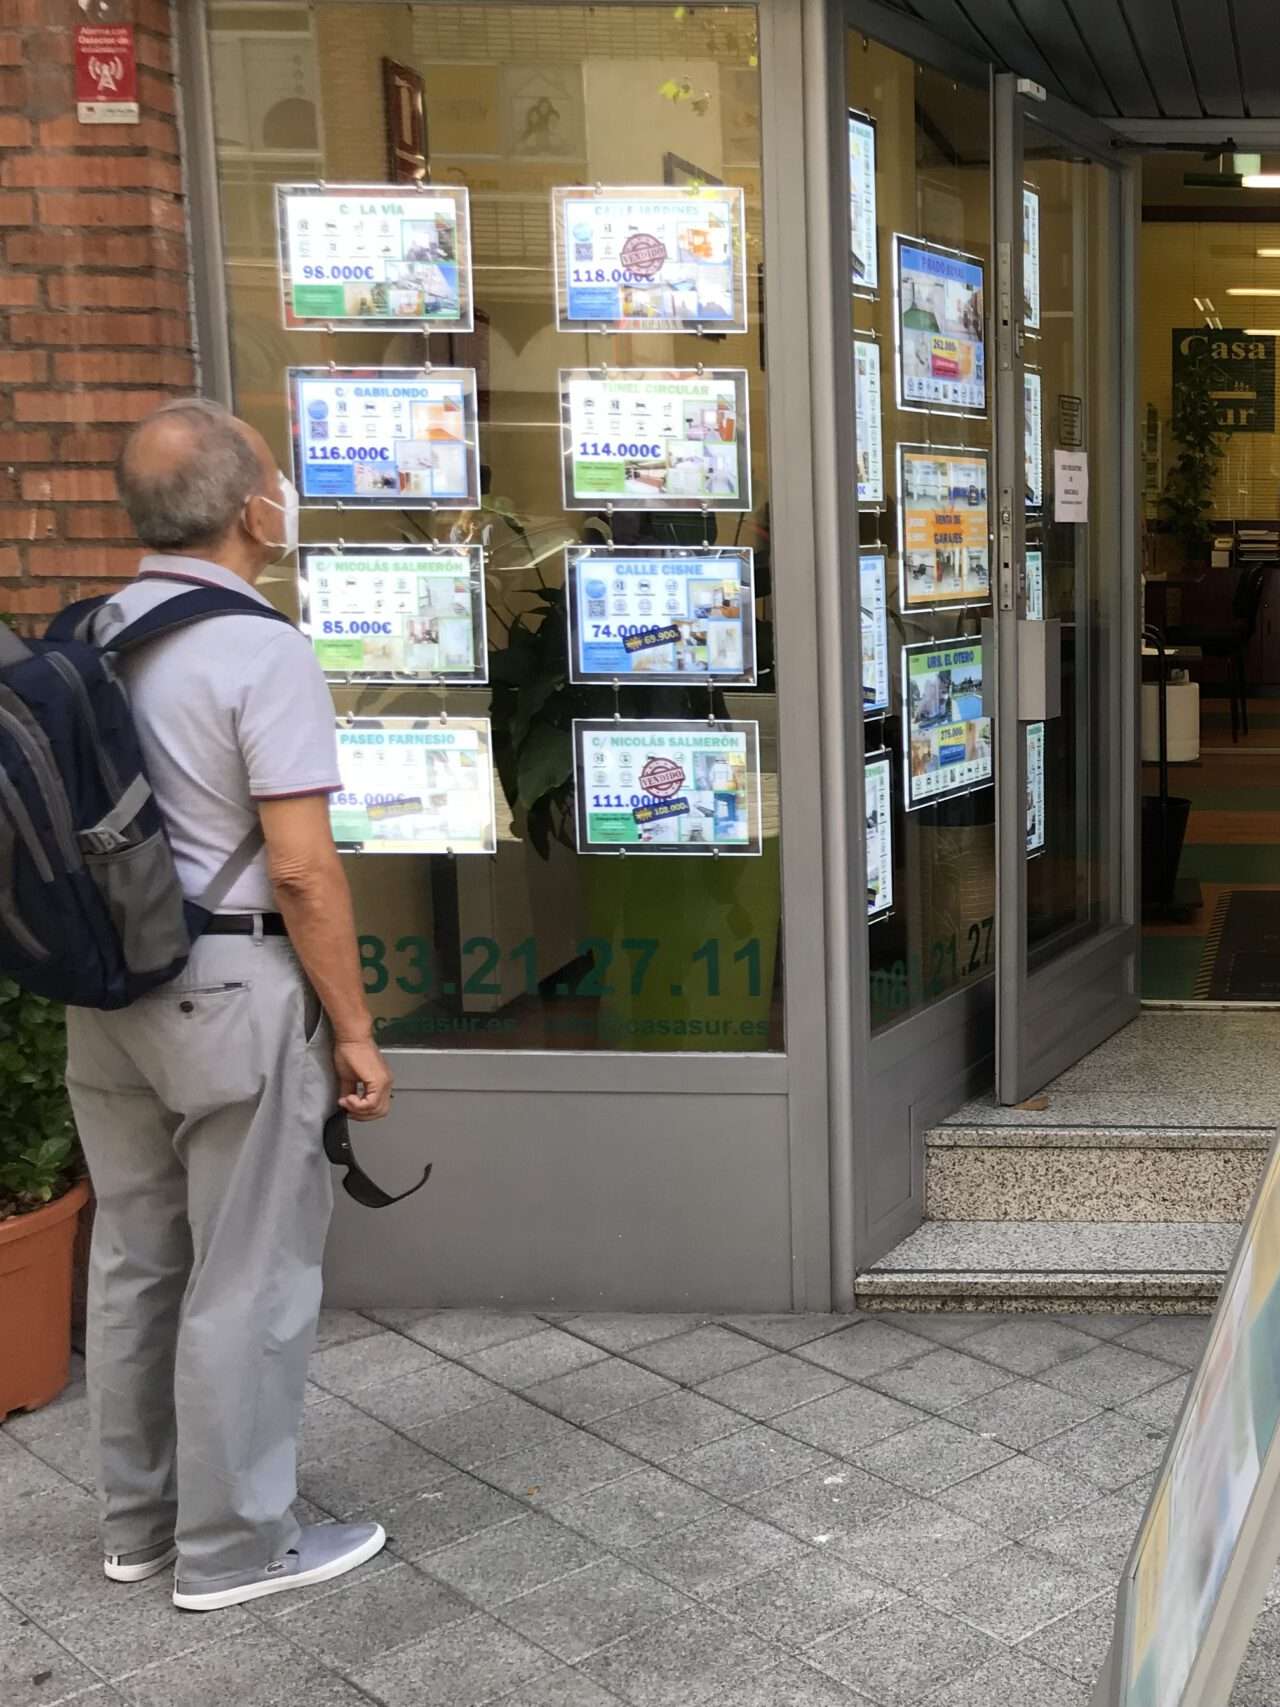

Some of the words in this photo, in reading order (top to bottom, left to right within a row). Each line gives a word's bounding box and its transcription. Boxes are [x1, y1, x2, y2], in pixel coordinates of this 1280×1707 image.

[303, 265, 375, 280] 98.000€
[1180, 335, 1267, 360] Casa
[308, 447, 390, 461] 116.000€
[580, 443, 662, 458] 114.000€
[615, 564, 659, 576] CALLE
[322, 620, 393, 635] 85.000€
[340, 734, 385, 746] PASEO
[388, 734, 456, 746] FARNESIO
[610, 734, 666, 748] NICOLÁS
[668, 735, 739, 748] SALMERÓN
[641, 769, 685, 788] VENDIDO
